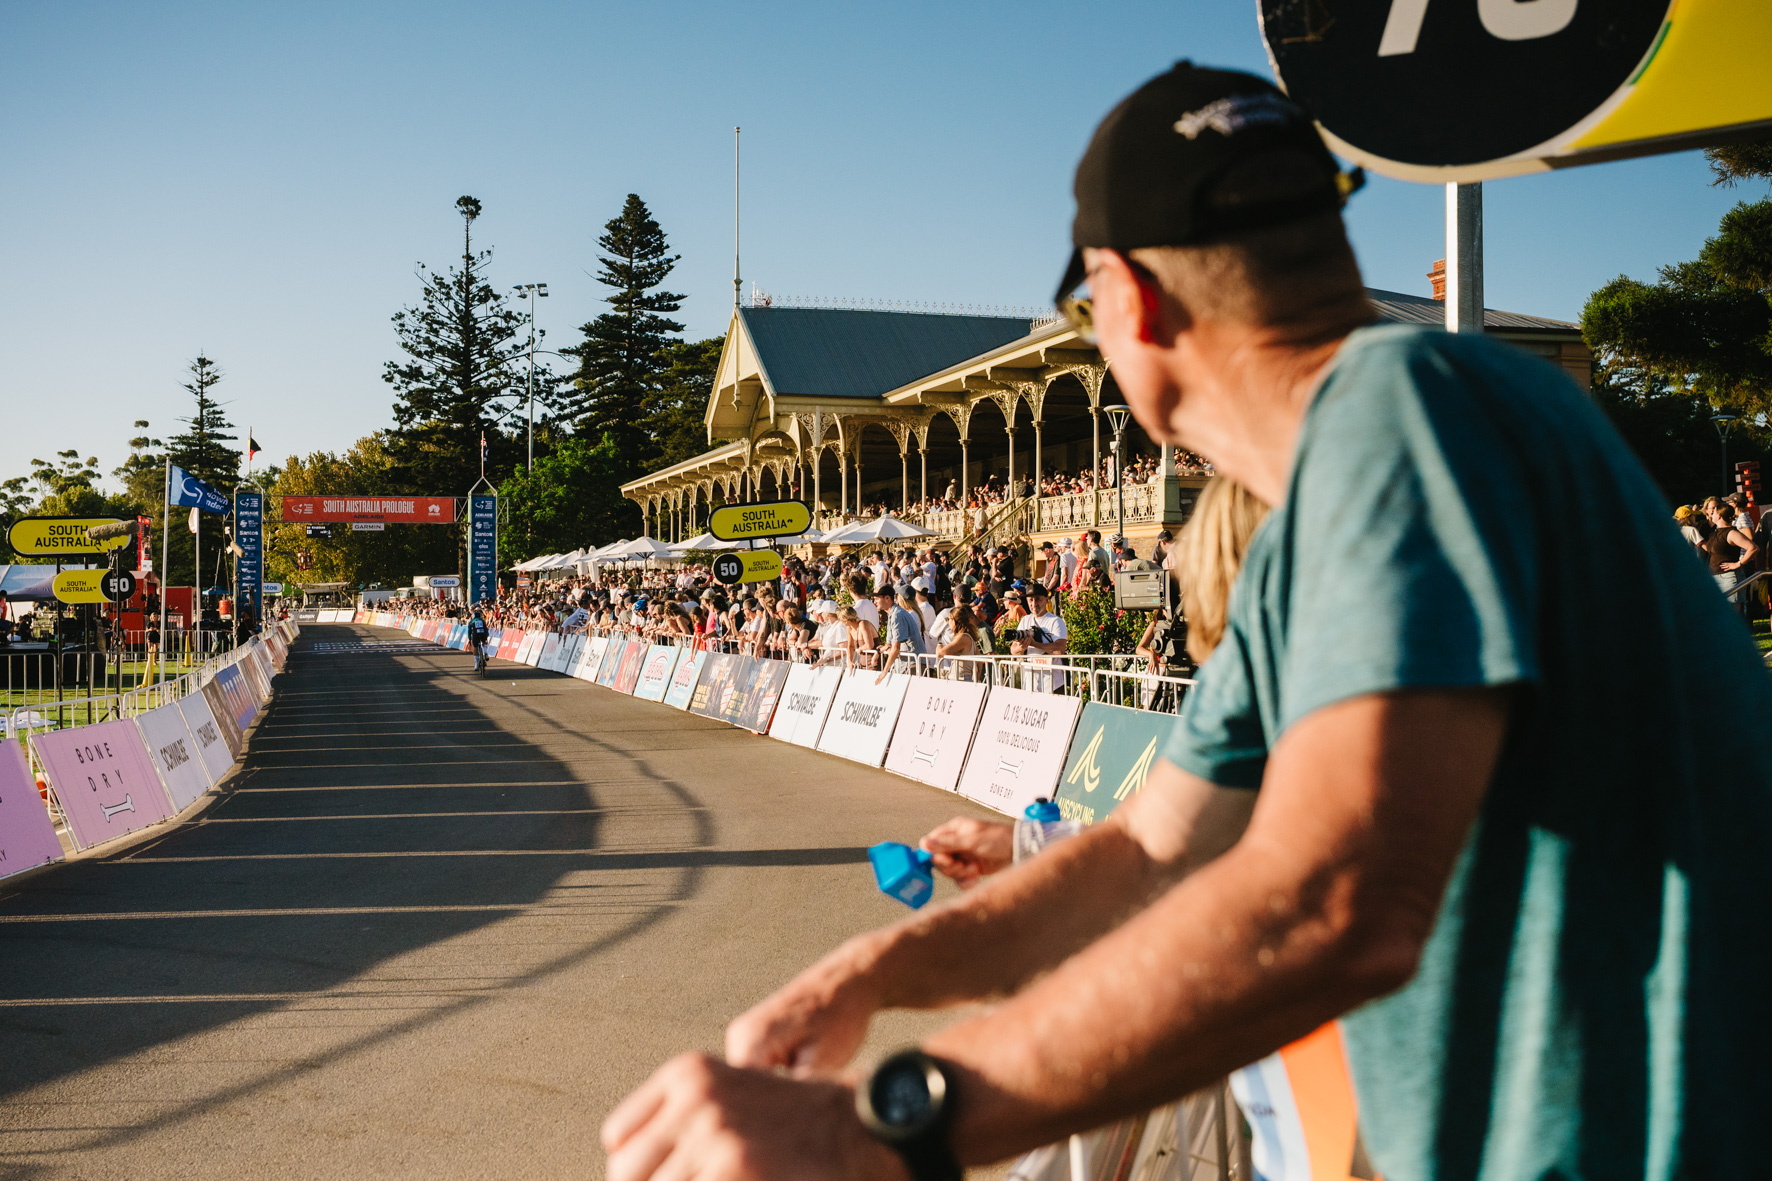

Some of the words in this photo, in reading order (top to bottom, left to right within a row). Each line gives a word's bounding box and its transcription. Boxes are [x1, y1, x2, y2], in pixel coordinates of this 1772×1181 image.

[323, 500, 345, 513] SOUTH
[346, 500, 380, 513] AUSTRALIA
[381, 500, 415, 514] PROLOGUE
[742, 510, 775, 522] SOUTH
[48, 525, 89, 536] SOUTH
[732, 520, 788, 533] AUSTRALIA
[34, 537, 102, 547] AUSTRALIA
[720, 562, 738, 577] 50
[747, 564, 776, 572] AUSTRALIA
[109, 577, 130, 593] 50
[787, 692, 818, 715] SCHWALBE
[926, 696, 954, 714] BONE
[840, 700, 882, 728] SCHWALBE
[1003, 703, 1022, 723] 0.1%
[1021, 707, 1049, 730] SUGAR
[918, 721, 946, 740] DRY
[996, 730, 1011, 745] 100%
[1010, 732, 1040, 753] DELICIOUS
[74, 742, 113, 764] BONE
[87, 769, 124, 792] DRY
[989, 782, 1005, 797] BONE
[1004, 788, 1014, 800] DRY
